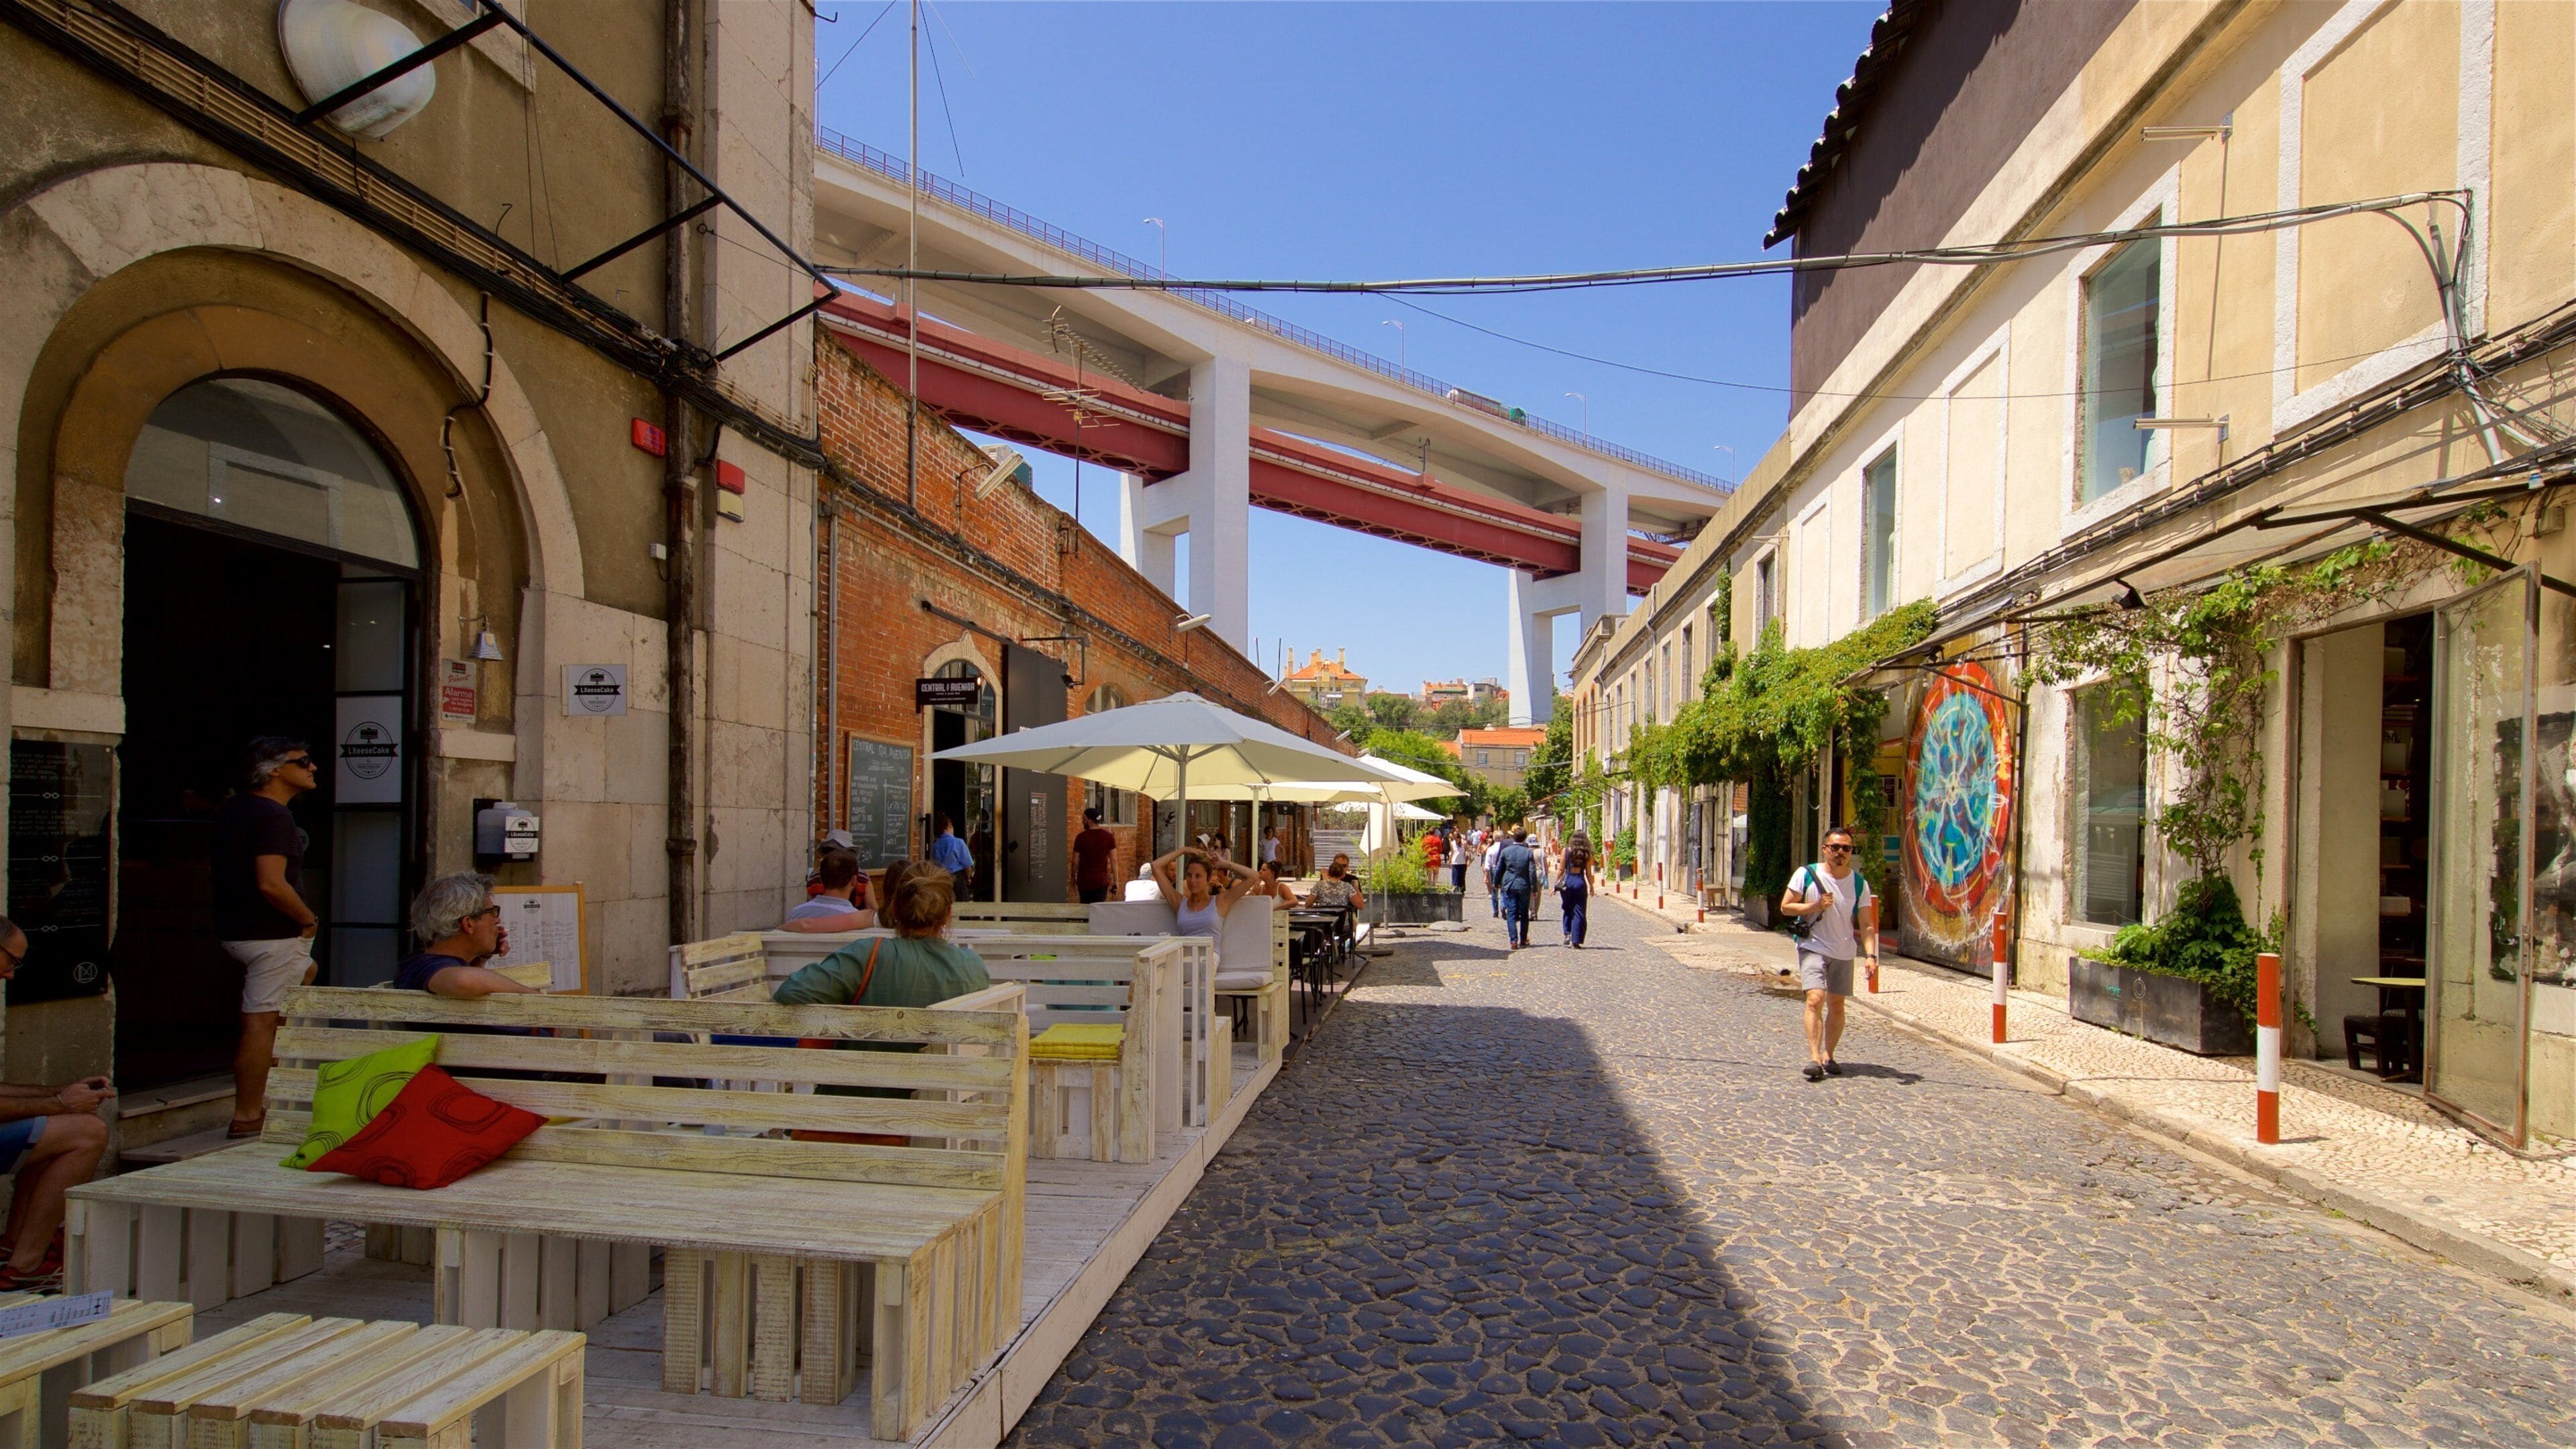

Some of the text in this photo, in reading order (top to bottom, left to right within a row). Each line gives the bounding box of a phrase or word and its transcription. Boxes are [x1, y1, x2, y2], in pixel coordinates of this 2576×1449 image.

[921, 683, 946, 692] CENTRAL
[950, 682, 975, 692] AVENIDA
[445, 687, 473, 698] Alarme
[348, 747, 390, 755] LXeeseCake
[853, 739, 875, 754] CENTRAL
